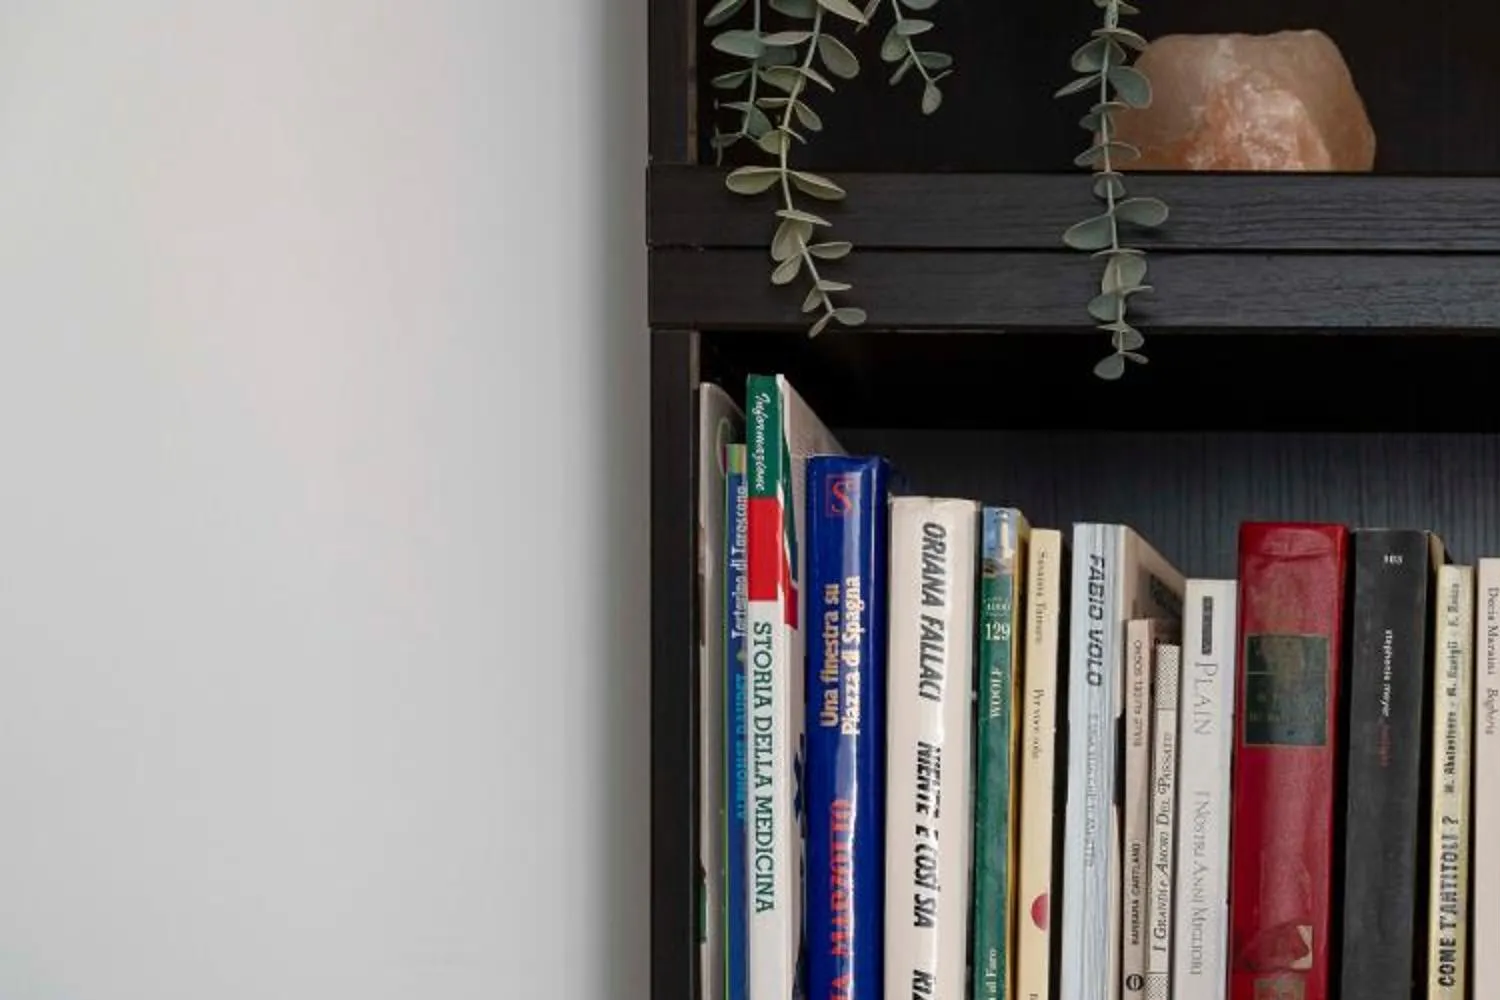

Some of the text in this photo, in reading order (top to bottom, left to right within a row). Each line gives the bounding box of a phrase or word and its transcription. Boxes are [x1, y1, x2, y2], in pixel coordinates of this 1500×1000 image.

[754, 392, 772, 493] Informazione
[920, 521, 947, 607] ORIANA
[820, 582, 840, 727] Una finestra su
[841, 575, 865, 735] Piazza di Spagna
[918, 613, 945, 703] FALLACI
[985, 622, 1011, 642] 129
[1086, 554, 1106, 688] FABIO VOLO
[1487, 625, 1500, 675] Maraini
[1192, 661, 1219, 736] PLAIN
[753, 621, 774, 914] STORIA DELLA MEDICINA
[916, 740, 942, 815] NIENTE
[1441, 815, 1459, 825] ?
[913, 893, 937, 929] SIA
[1437, 937, 1457, 988] COME
